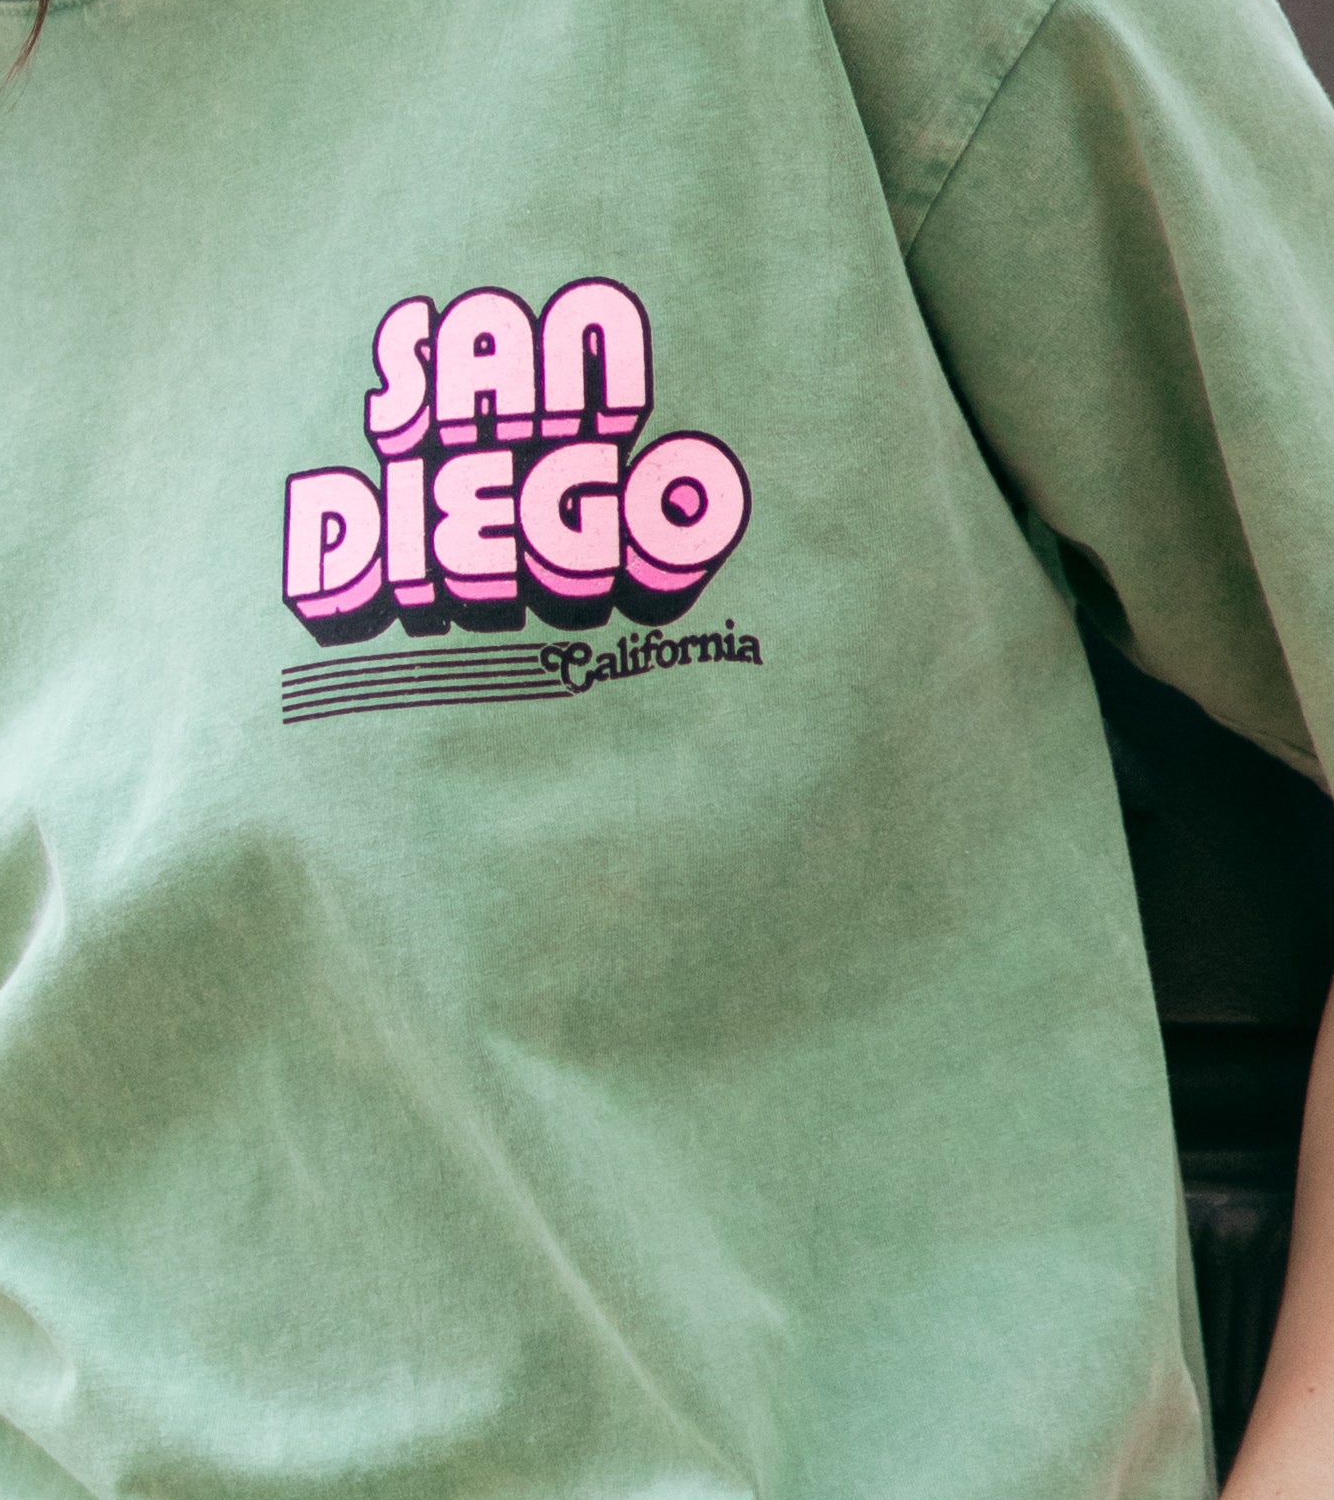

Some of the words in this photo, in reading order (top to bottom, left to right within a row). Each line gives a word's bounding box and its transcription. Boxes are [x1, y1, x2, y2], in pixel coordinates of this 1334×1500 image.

[364, 277, 654, 454] SAN
[283, 430, 752, 640] DIEGO
[540, 620, 763, 693] California
